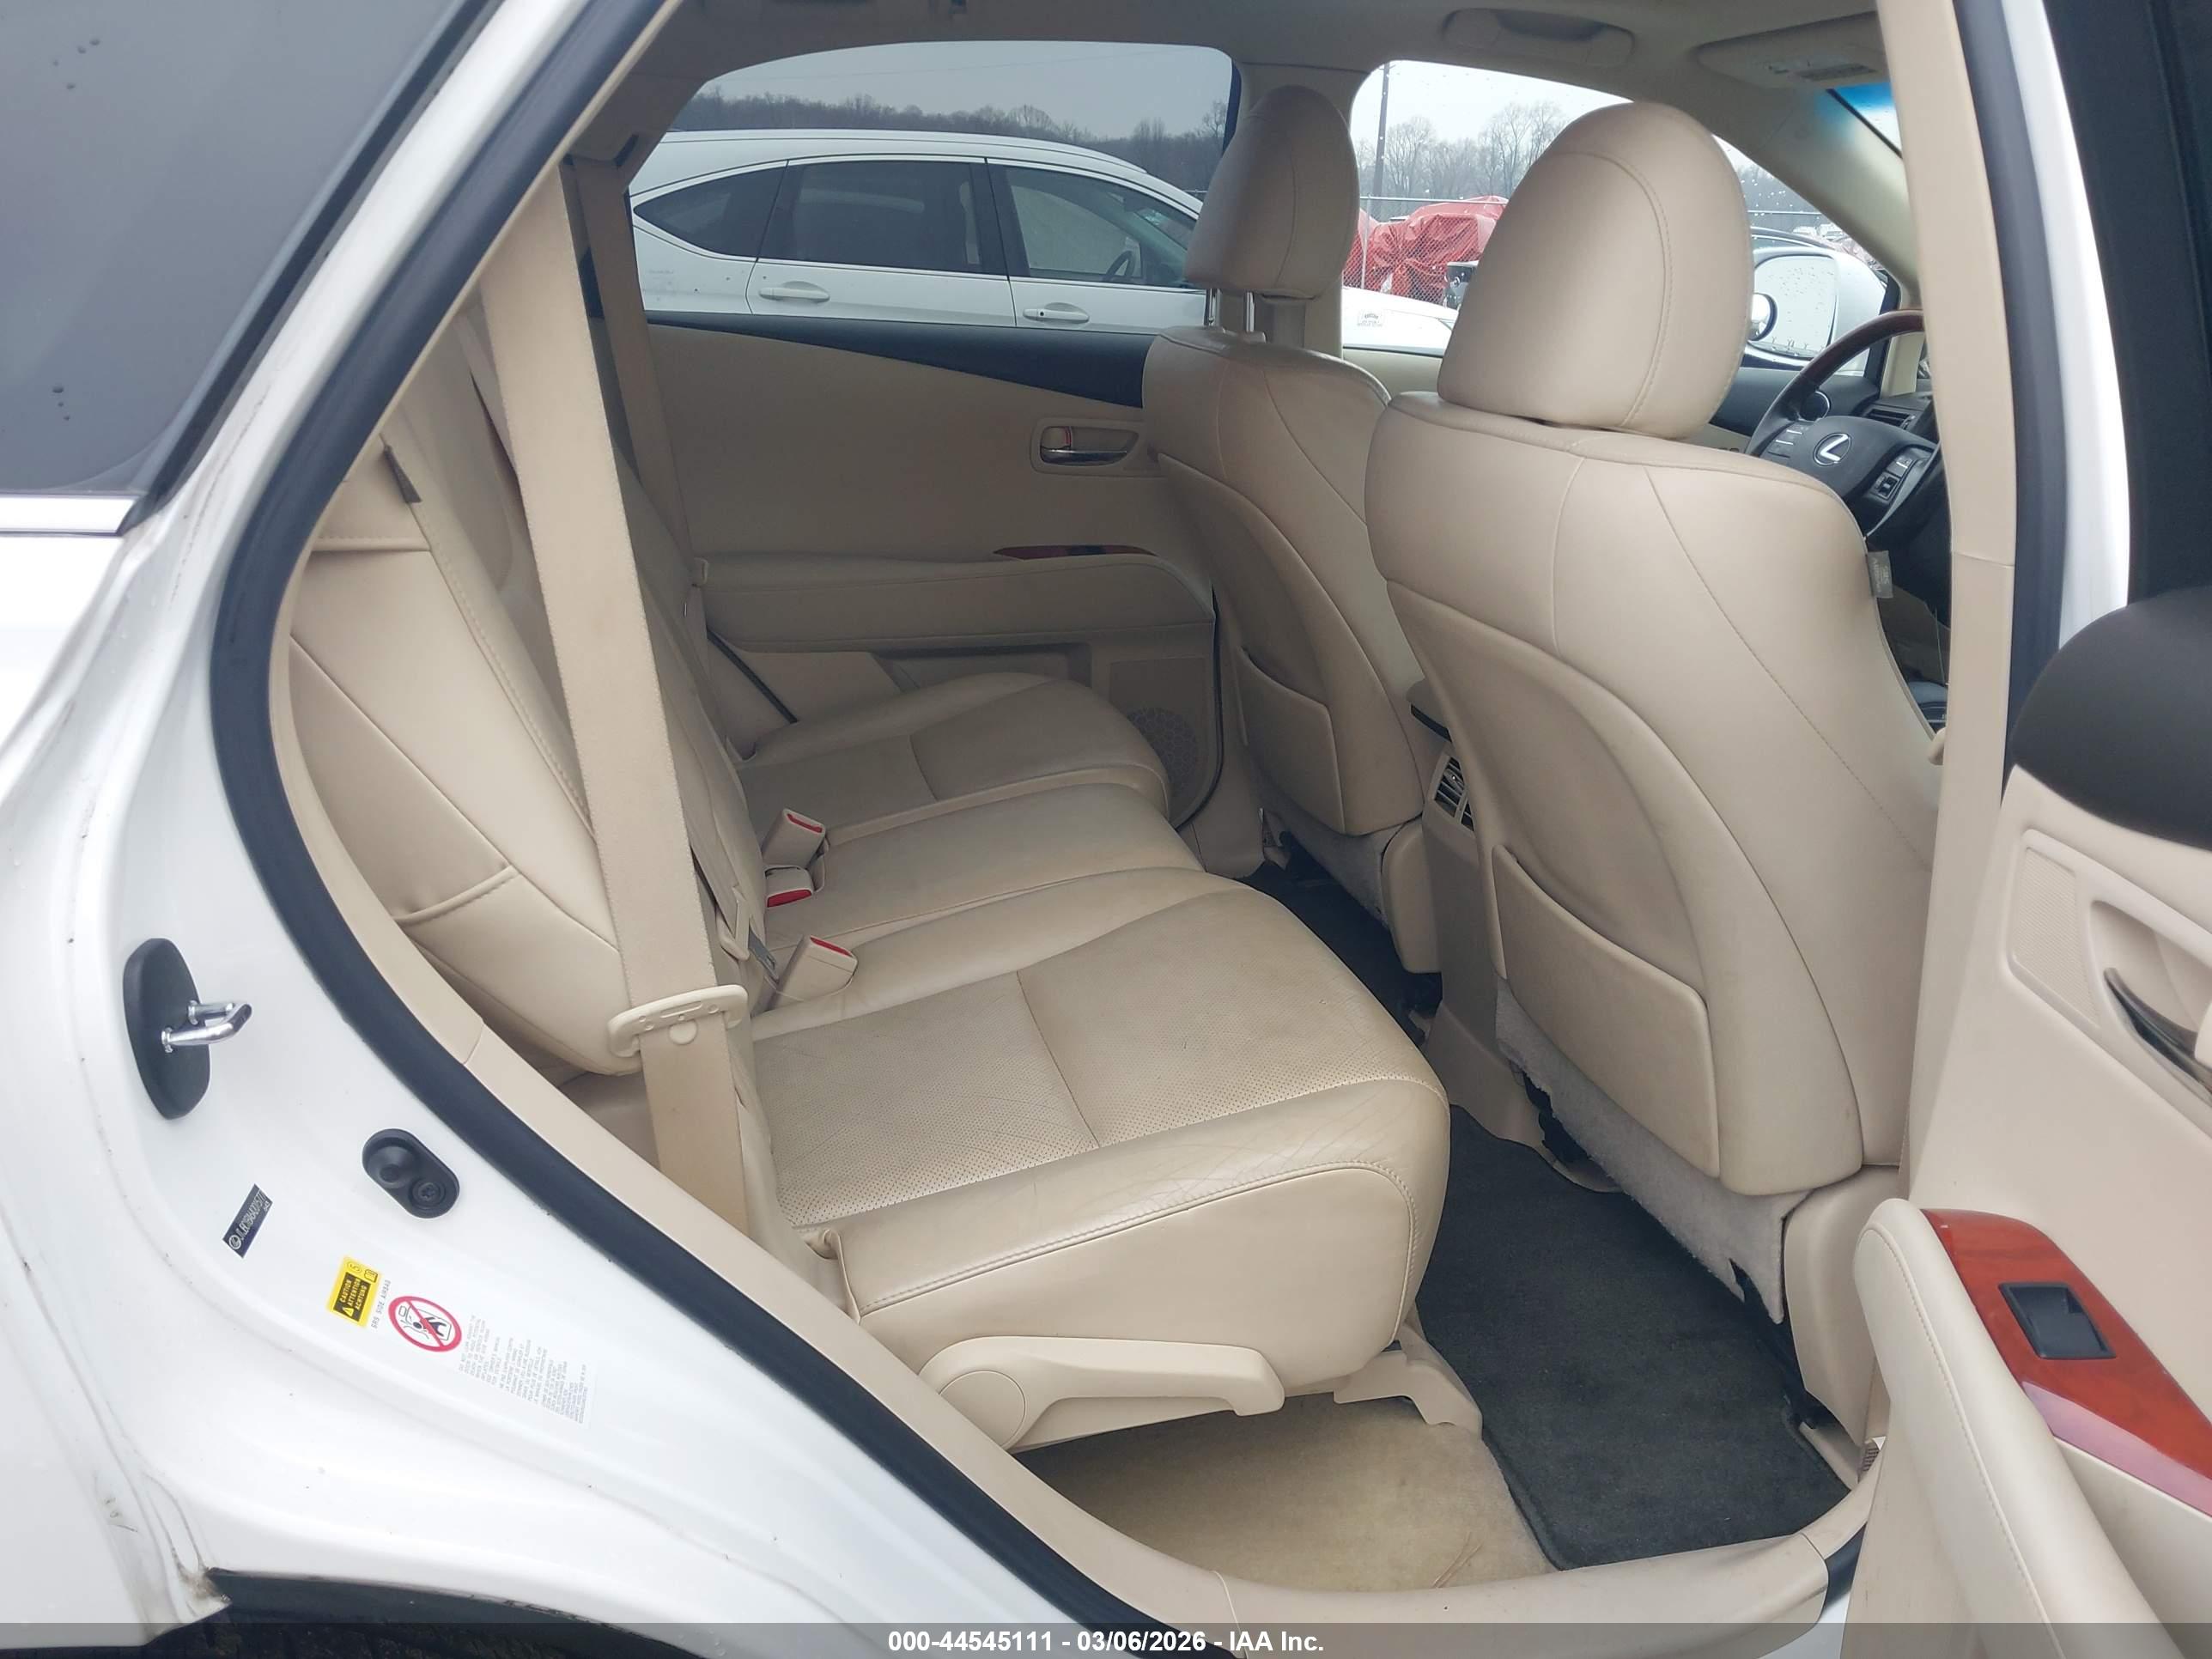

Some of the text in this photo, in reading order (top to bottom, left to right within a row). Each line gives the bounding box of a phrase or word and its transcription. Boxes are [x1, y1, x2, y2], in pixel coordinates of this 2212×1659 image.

[339, 1279, 352, 1304] CAUTION
[347, 1278, 362, 1307] ATTENTION
[355, 1285, 368, 1310] ACHTUNG
